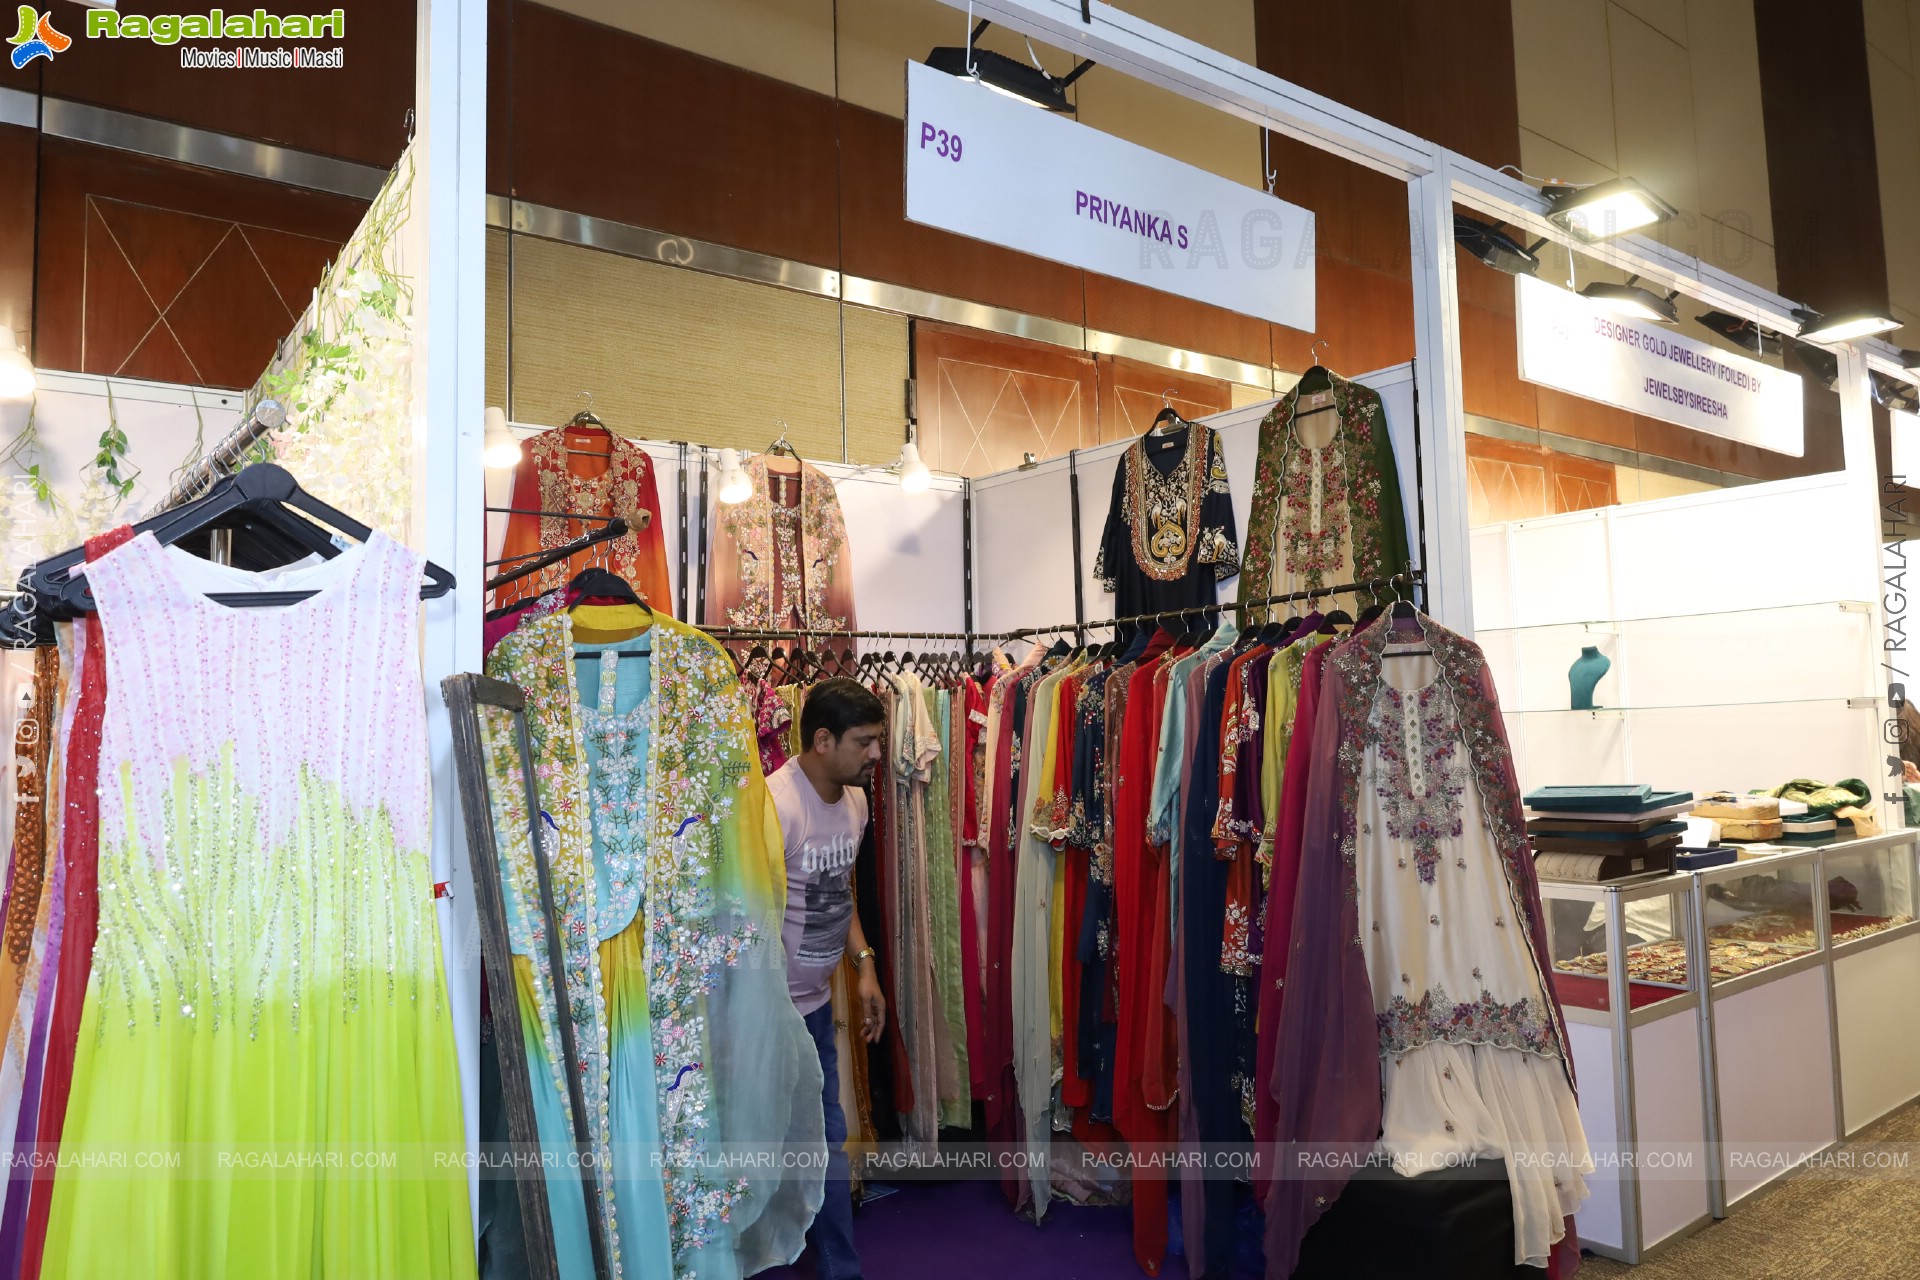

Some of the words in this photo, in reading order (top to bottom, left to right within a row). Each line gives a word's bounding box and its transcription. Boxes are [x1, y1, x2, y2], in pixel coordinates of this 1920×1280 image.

[919, 121, 963, 163] P39
[1075, 189, 1173, 246] PRIYANKA
[1177, 224, 1189, 250] S
[1594, 316, 1641, 349] DESIGNER
[1642, 333, 1667, 358] GOLD
[1669, 344, 1717, 376] JEWELLERY
[1752, 377, 1762, 395] BY
[1643, 376, 1729, 420] JEWELSBYSIREESHA
